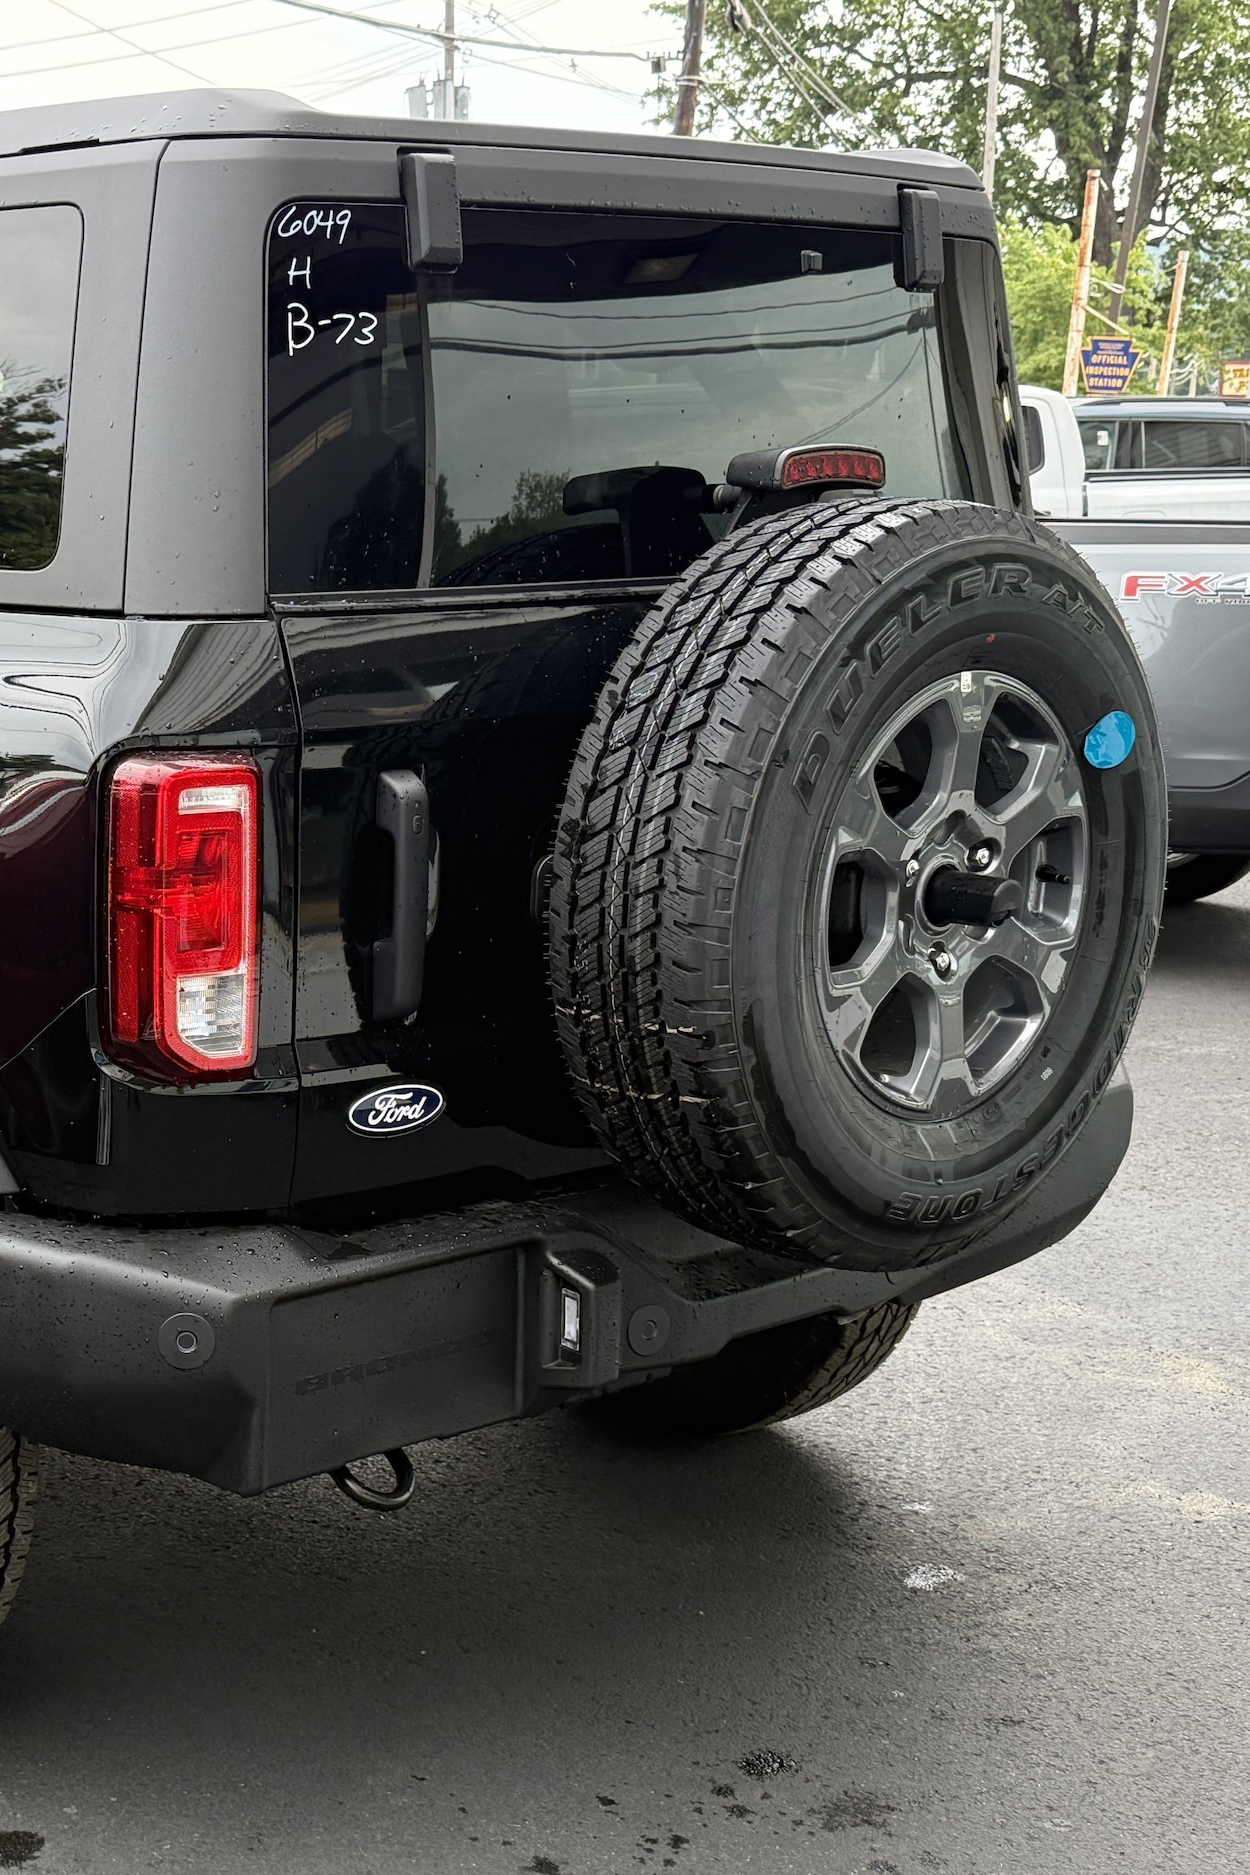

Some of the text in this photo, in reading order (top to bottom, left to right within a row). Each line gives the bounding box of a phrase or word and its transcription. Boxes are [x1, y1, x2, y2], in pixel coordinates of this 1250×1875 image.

[277, 205, 352, 245] 6049
[287, 255, 312, 289] H
[286, 302, 379, 357] B-73
[1085, 366, 1130, 377] INSPECTION
[1091, 353, 1128, 365] OFFICIAL
[1088, 377, 1123, 388] STATION
[792, 562, 1032, 814] DUELER
[367, 1091, 428, 1126] Ford
